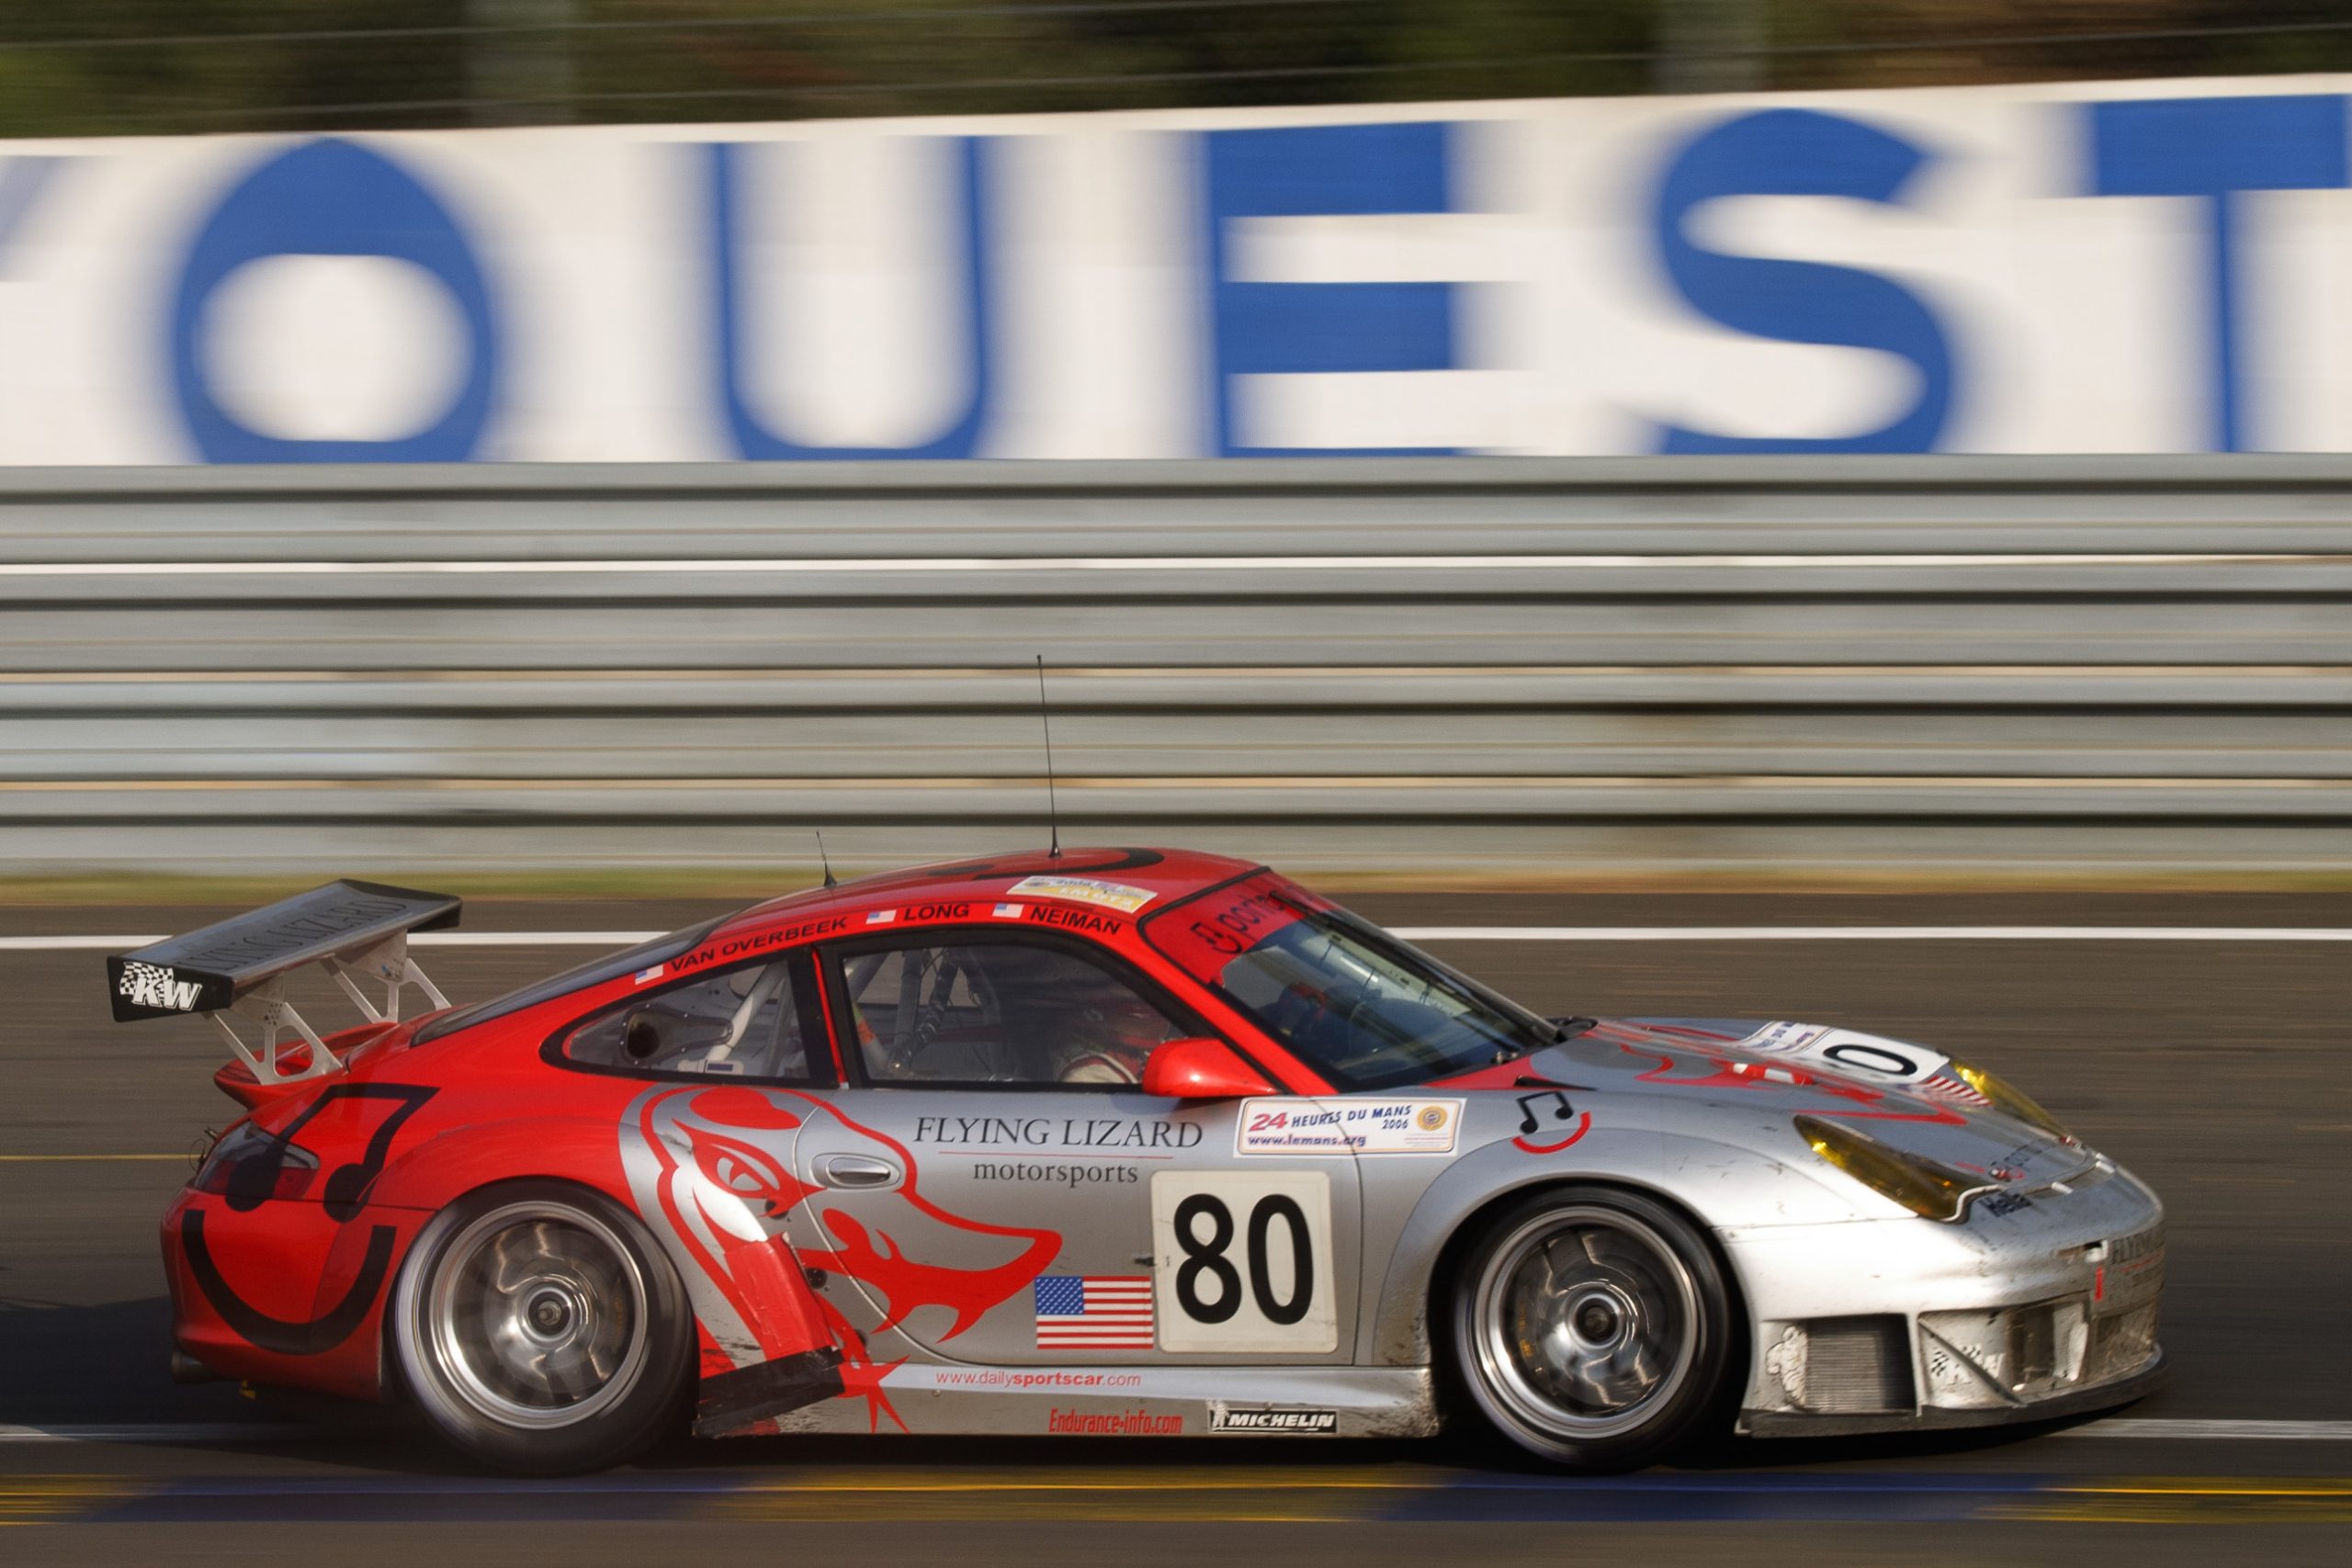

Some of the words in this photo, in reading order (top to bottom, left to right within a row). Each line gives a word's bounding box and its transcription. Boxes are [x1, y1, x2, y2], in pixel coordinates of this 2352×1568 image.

[671, 948, 715, 972] VAN
[722, 917, 848, 956] OVERBEEK
[904, 903, 969, 921] LONG
[1029, 906, 1121, 936] NEIMAN
[131, 974, 203, 1010] KW
[1248, 1111, 1288, 1132] 24
[1291, 1111, 1341, 1128] HEURES
[1348, 1110, 1367, 1122] DU
[1372, 1105, 1412, 1118] MANS
[1382, 1119, 1408, 1130] 2006
[913, 1117, 1050, 1145] FLYING
[1062, 1119, 1203, 1148] LIZARD
[1248, 1134, 1367, 1146] www.lemans.org
[973, 1162, 1138, 1189] motorsports
[1173, 1192, 1314, 1325] 80
[936, 1370, 1141, 1388] www.dailysportscar.com
[1227, 1413, 1336, 1428] MICHELIN
